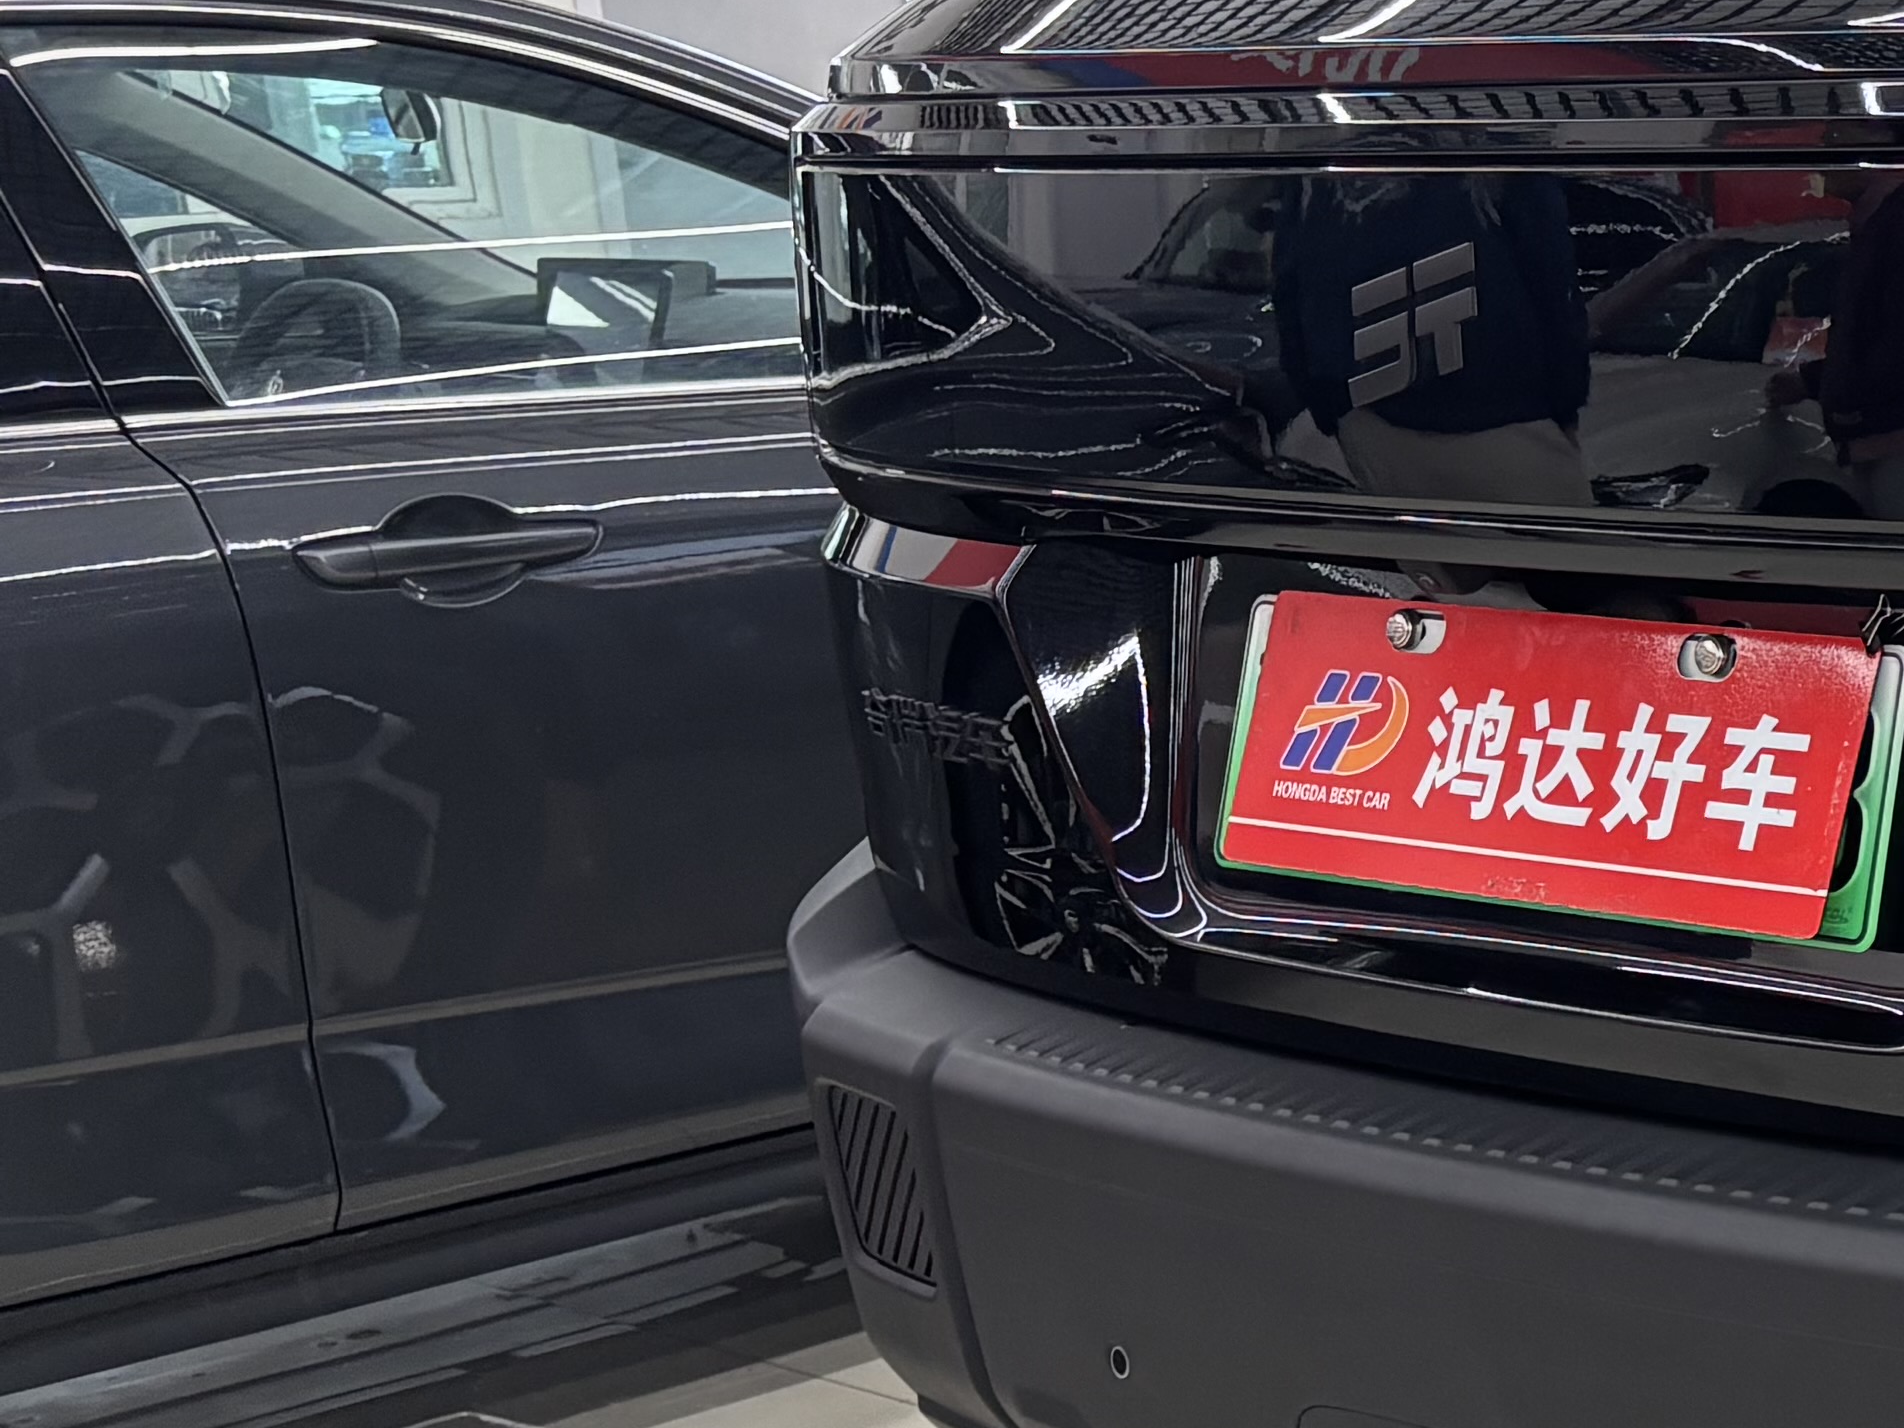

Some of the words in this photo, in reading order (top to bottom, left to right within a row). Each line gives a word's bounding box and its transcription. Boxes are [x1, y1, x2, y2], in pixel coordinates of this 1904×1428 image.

[1272, 779, 1327, 803] HONGDA
[1328, 786, 1364, 806] BEST
[1362, 791, 1391, 811] CAR
[1412, 685, 1812, 852] 鸿达好车
